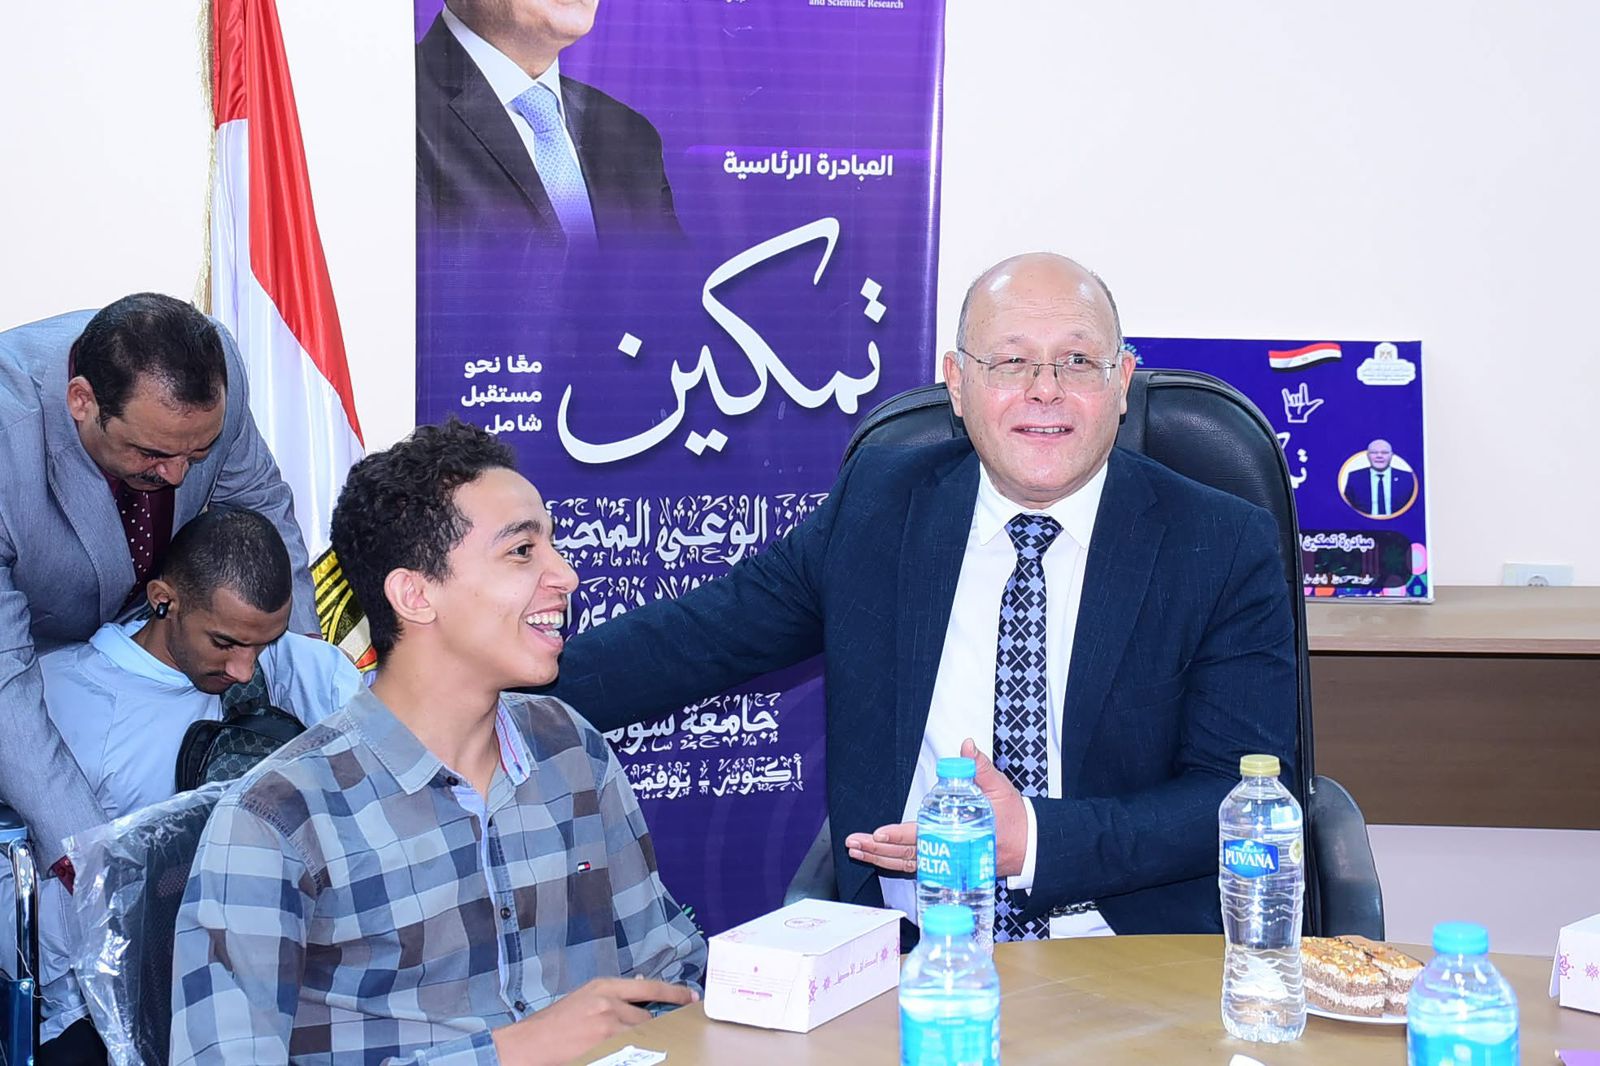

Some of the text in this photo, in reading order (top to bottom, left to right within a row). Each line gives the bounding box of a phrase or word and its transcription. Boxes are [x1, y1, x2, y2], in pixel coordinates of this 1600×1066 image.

[827, 0, 866, 8] Scientific
[867, 0, 904, 9] Research
[723, 151, 894, 180] المبادرة الرئاسية
[557, 216, 887, 464] تمكين
[463, 356, 501, 379] نحو
[460, 384, 543, 407] مستقبل
[484, 413, 543, 436] شامل
[552, 496, 652, 561] المجت
[655, 493, 768, 570] الوعي
[681, 693, 780, 740] جامعة
[712, 753, 803, 797] أكتوبر
[1224, 847, 1276, 870] PUVANA
